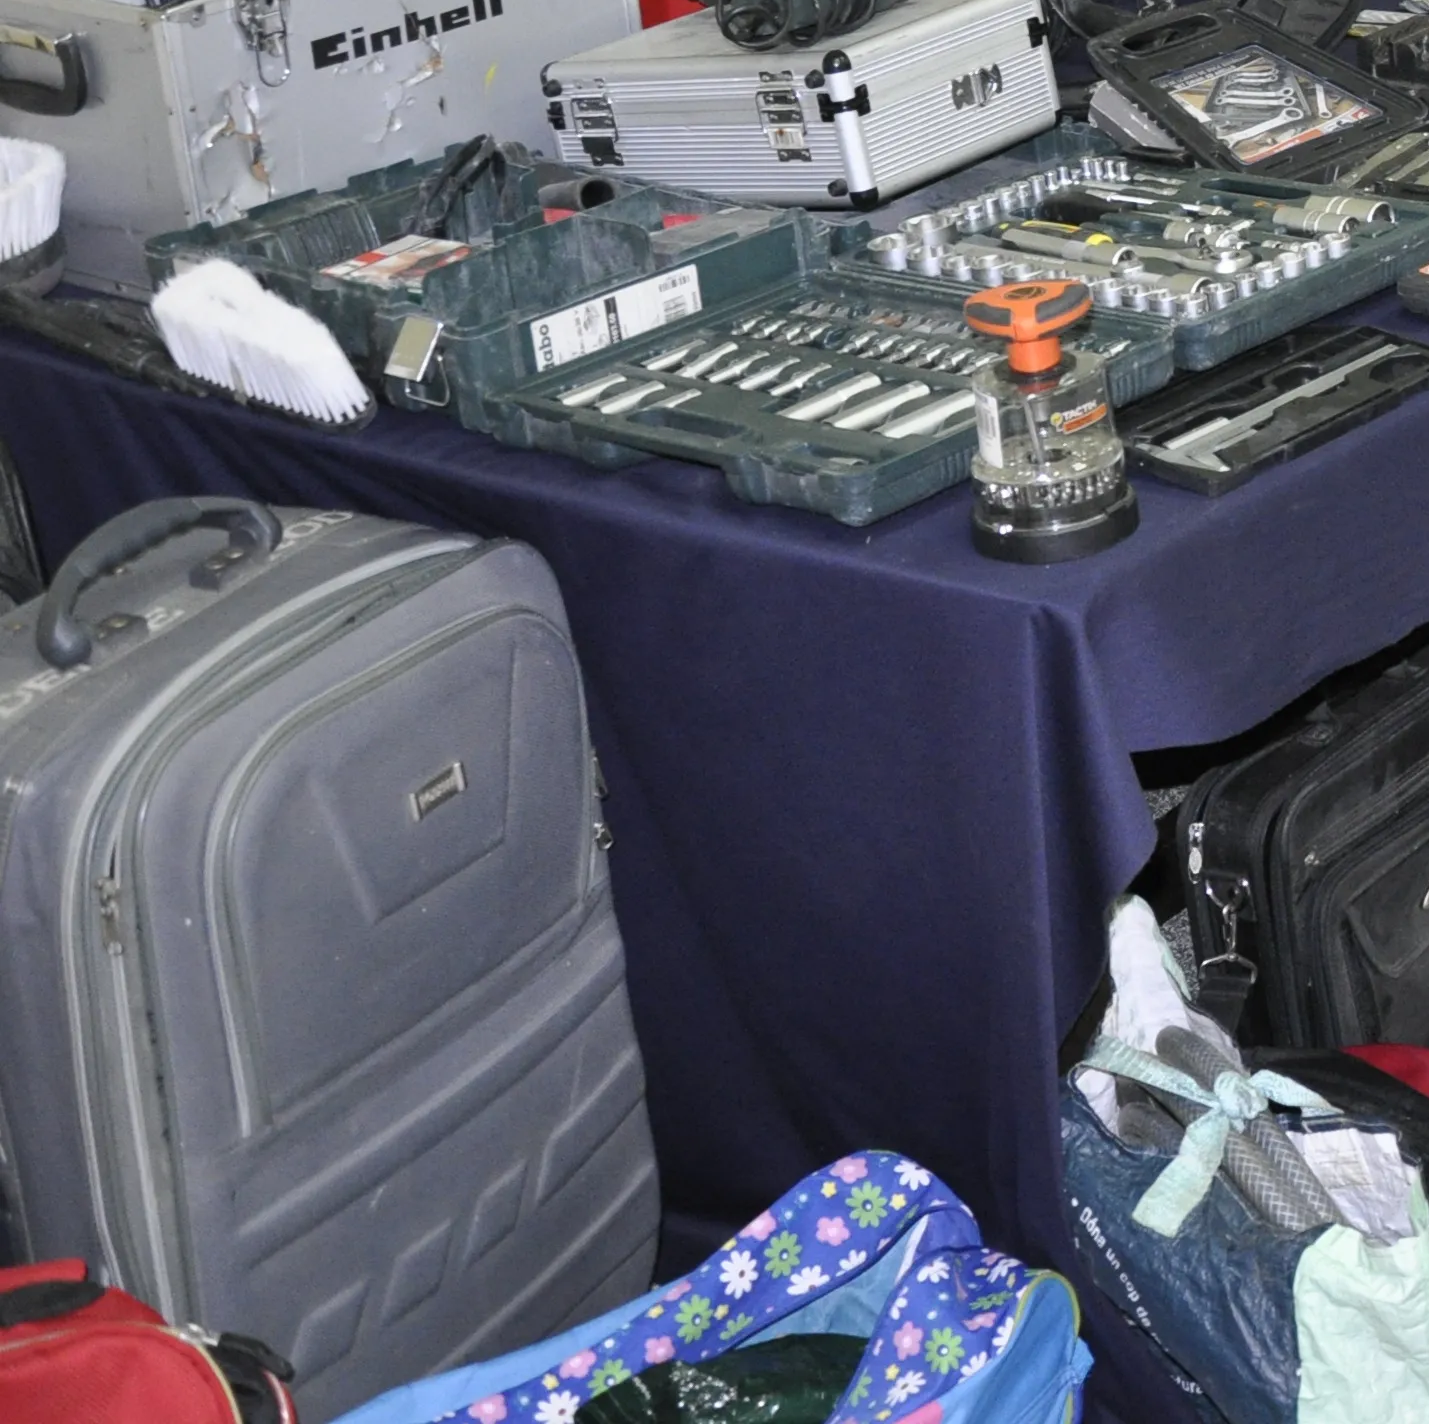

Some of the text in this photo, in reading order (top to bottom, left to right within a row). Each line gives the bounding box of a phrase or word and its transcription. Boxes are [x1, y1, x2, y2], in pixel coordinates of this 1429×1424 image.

[1079, 1206, 1151, 1327] Dóna un cop de
